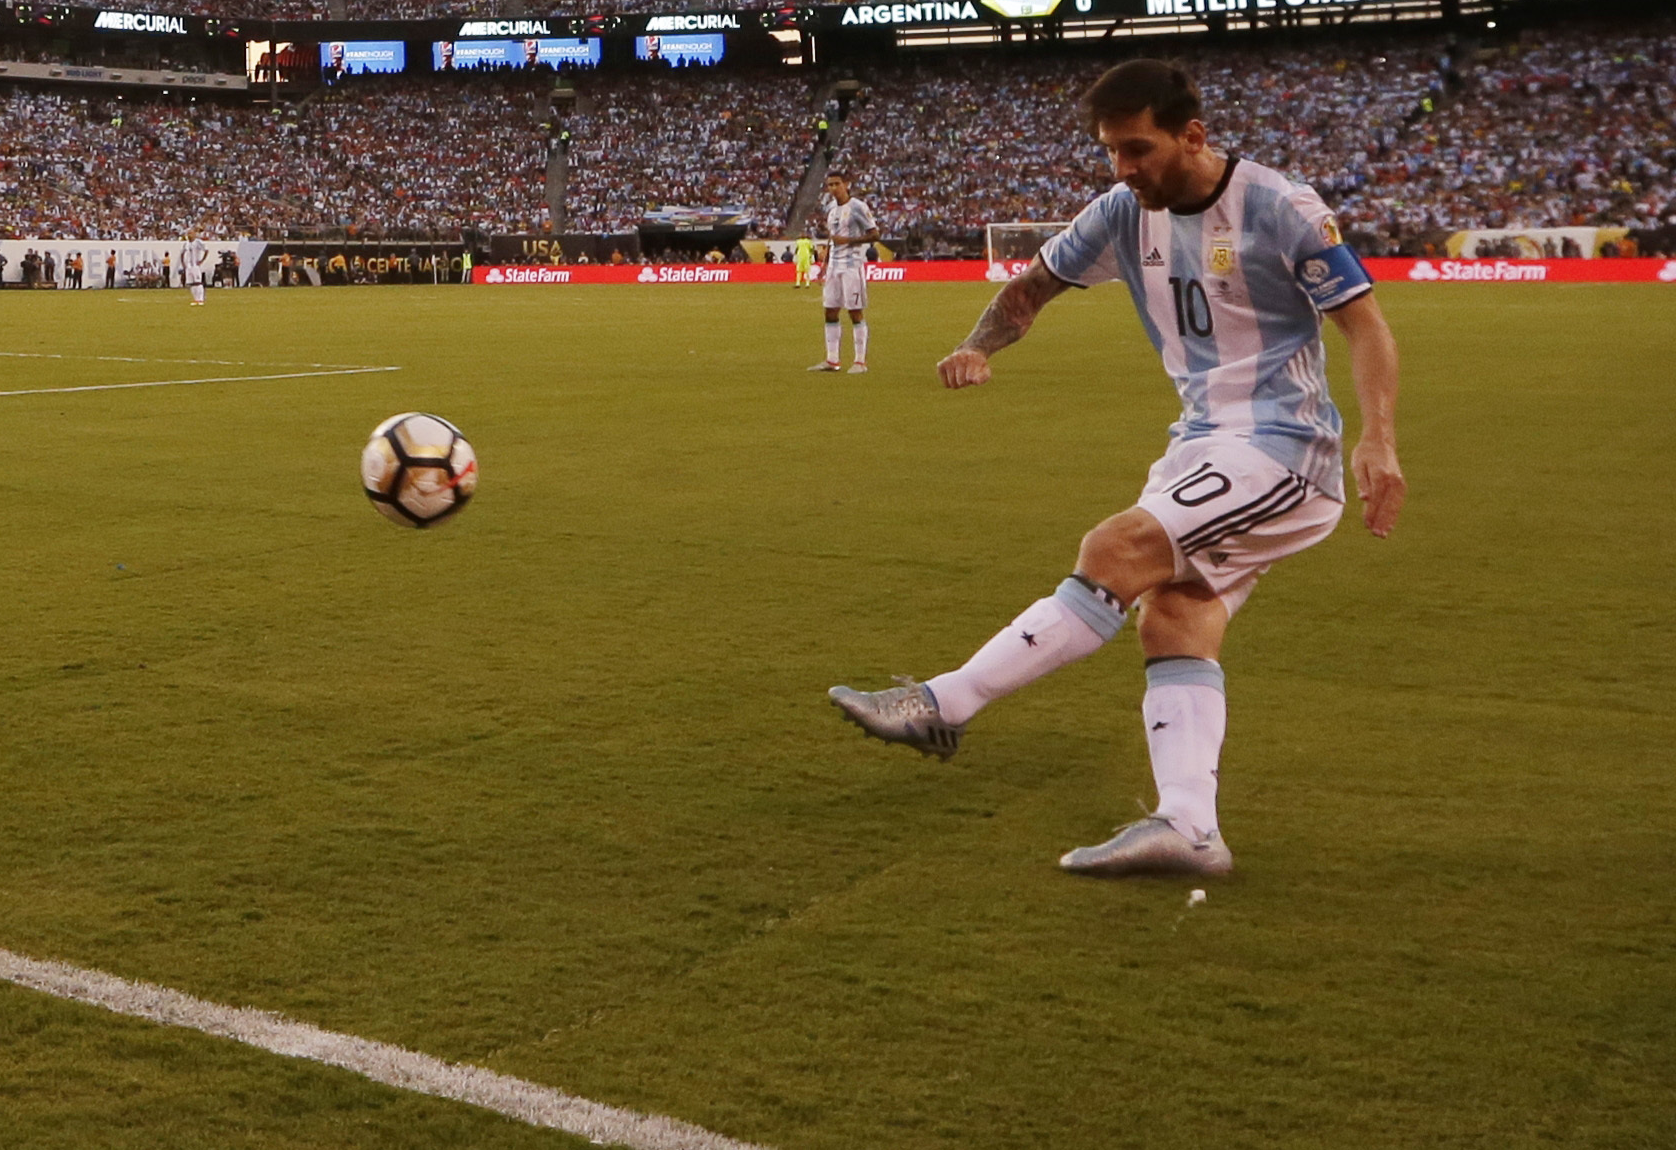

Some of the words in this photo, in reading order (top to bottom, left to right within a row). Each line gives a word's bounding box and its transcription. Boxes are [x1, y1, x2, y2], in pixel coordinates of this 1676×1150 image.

[842, 0, 978, 25] ARGENTINA
[94, 11, 187, 34] MERCURIAL
[458, 20, 551, 36] MERCURIAL
[646, 14, 740, 31] MERCURIAL
[182, 75, 206, 84] pepsi
[523, 239, 560, 257] USA
[852, 292, 859, 306] 7
[1168, 276, 1214, 338] 10
[1161, 462, 1232, 507] 10
